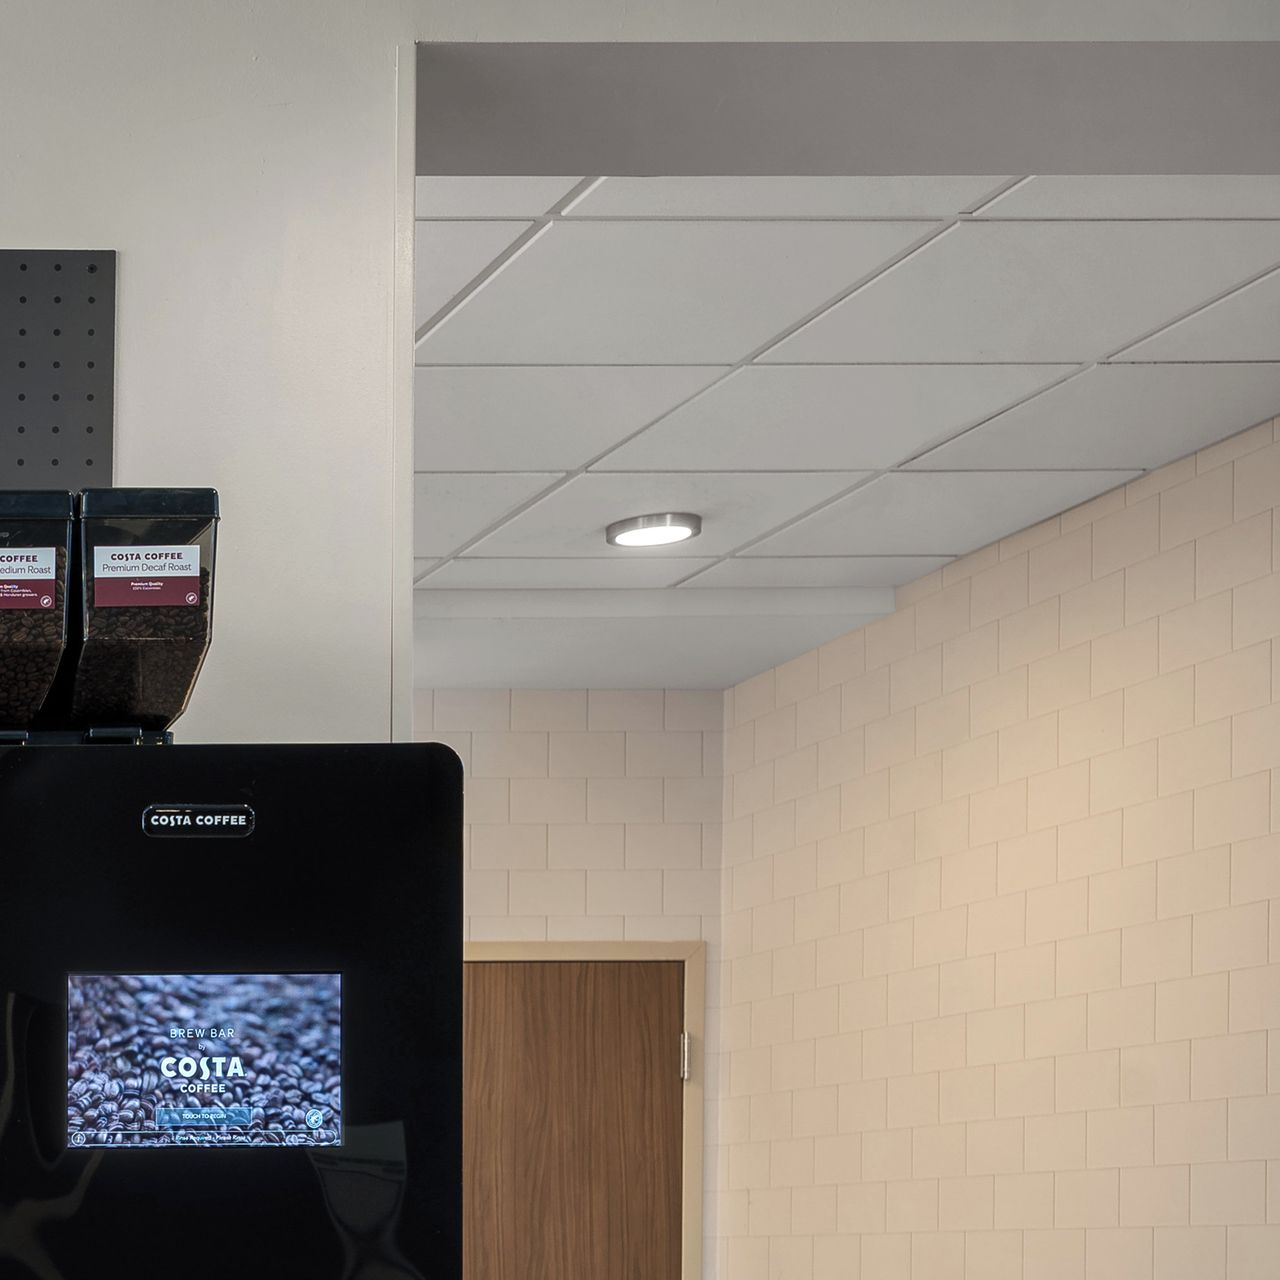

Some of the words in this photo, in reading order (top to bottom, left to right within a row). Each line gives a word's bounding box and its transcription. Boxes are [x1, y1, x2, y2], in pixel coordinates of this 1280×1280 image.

[111, 553, 141, 562] COSTA
[144, 552, 183, 560] COFFEE
[28, 566, 51, 574] Roast
[102, 564, 140, 572] Premium
[142, 563, 167, 572] Decaf
[168, 563, 192, 572] Roast
[150, 815, 192, 826] COSTA
[196, 815, 246, 826] COFFEE
[170, 1028, 205, 1038] BREW
[210, 1028, 234, 1038] BAR
[161, 1056, 244, 1080] COSTA
[180, 1084, 226, 1093] COFFEE
